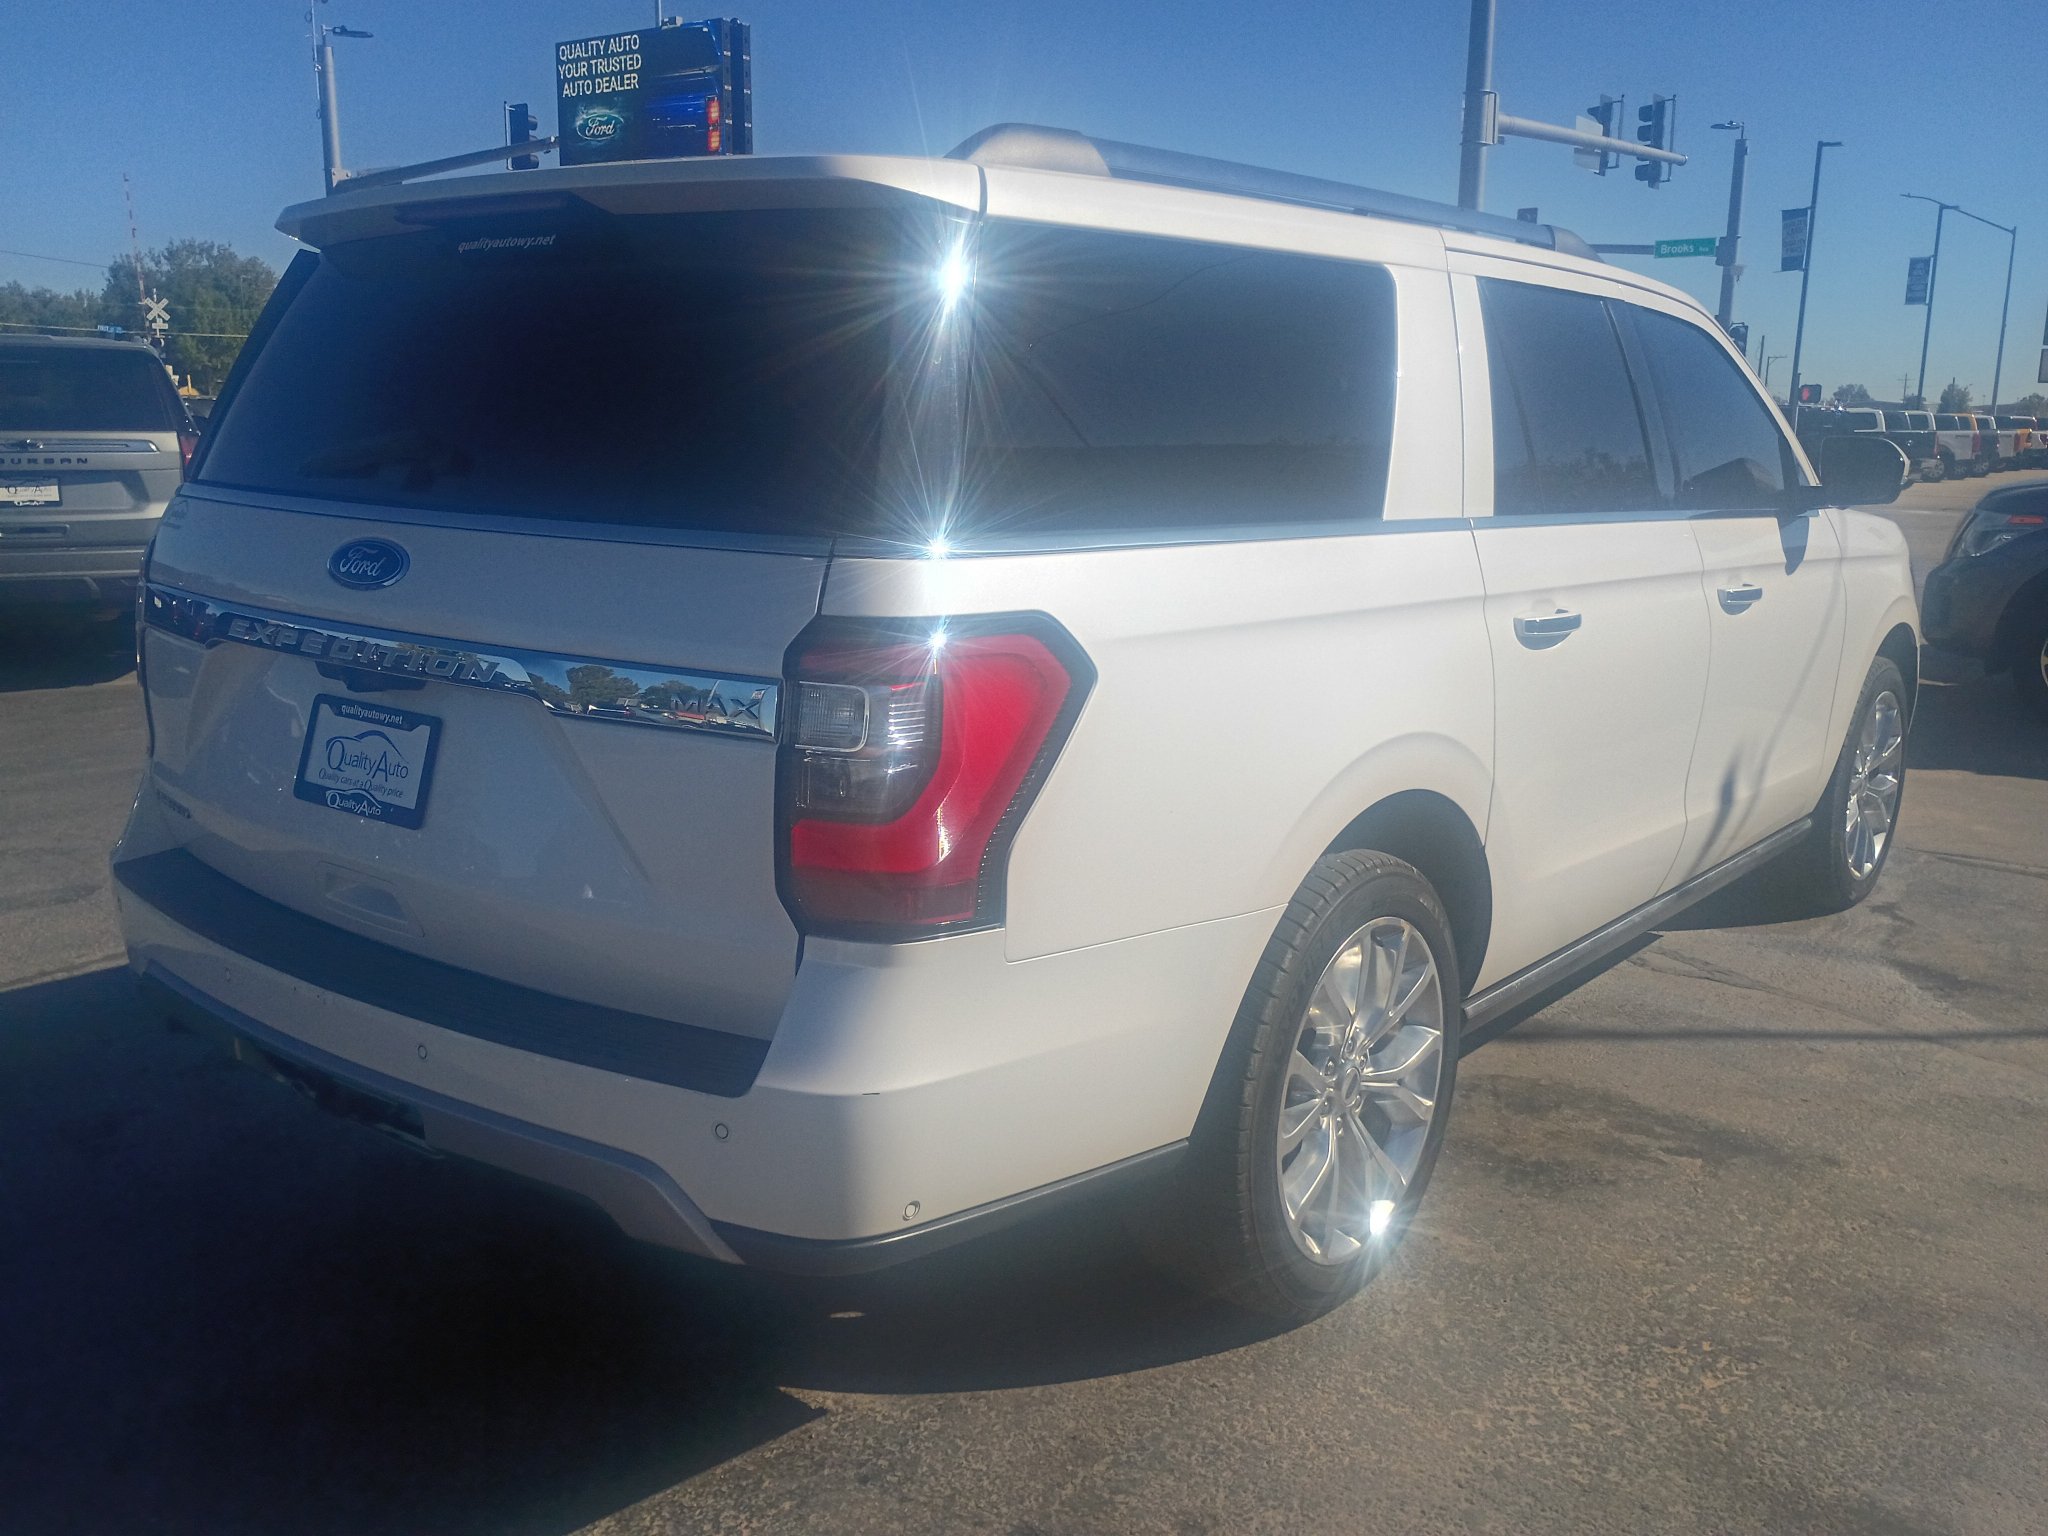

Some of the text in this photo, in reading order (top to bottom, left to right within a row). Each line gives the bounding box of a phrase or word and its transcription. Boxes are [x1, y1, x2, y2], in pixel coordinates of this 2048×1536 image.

[559, 34, 640, 61] QUALITY AUTO
[558, 53, 642, 80] YOUR TRUSTED
[562, 73, 639, 98] AUTO DEALER
[585, 115, 616, 137] Ford
[458, 234, 557, 254] qualityautowy.net
[1660, 244, 1694, 255] Brooks
[339, 546, 387, 577] Ford
[228, 618, 501, 683] EXPEDITION
[341, 704, 403, 725] qualityautowy.net
[670, 690, 765, 720] MAX
[318, 767, 339, 784] Quality
[340, 775, 353, 785] cars
[364, 778, 387, 796] Quality
[387, 787, 404, 798] price
